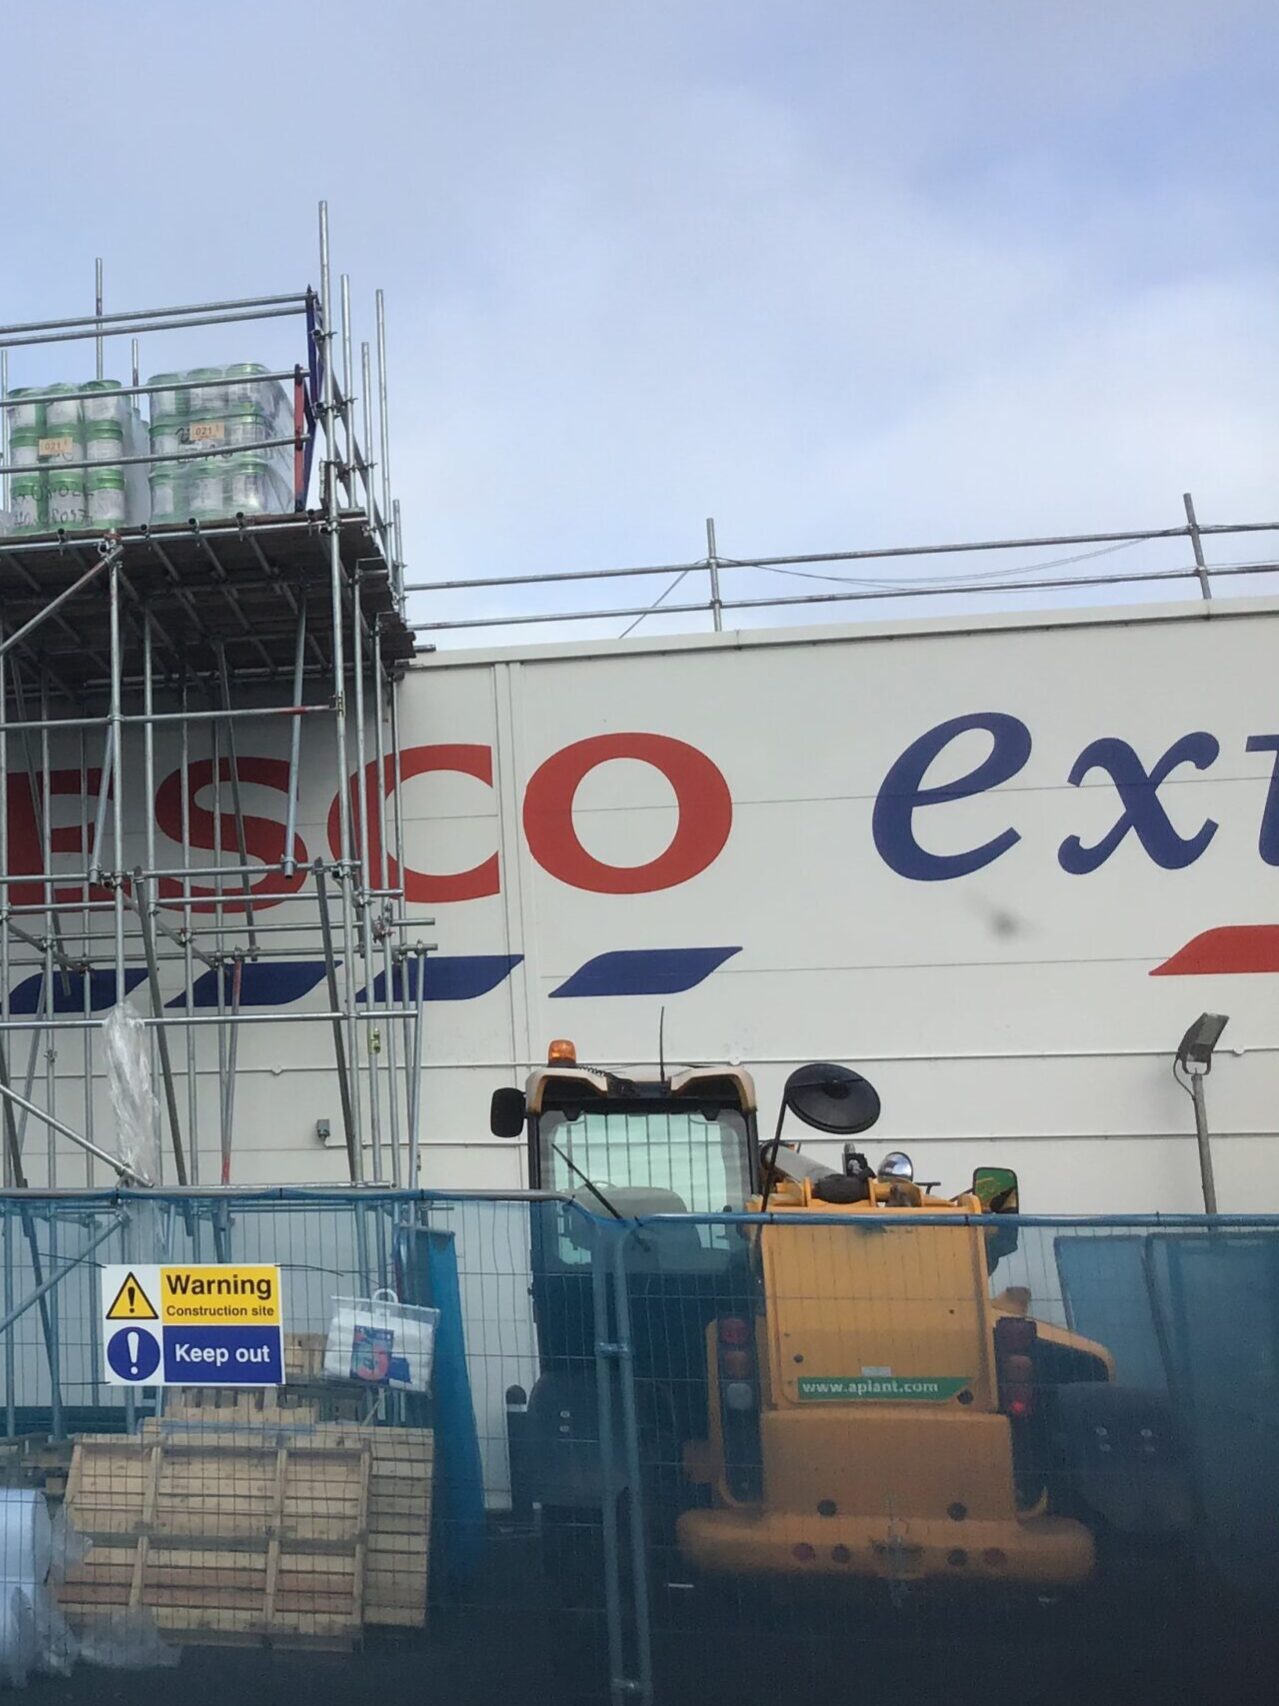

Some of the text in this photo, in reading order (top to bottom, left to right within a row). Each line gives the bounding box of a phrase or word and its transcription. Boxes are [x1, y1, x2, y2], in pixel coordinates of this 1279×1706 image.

[166, 1274, 272, 1300] Warning
[166, 1304, 274, 1317] Construction site
[175, 1344, 270, 1365] Keep out
[802, 1380, 938, 1394] www.aplant.com
